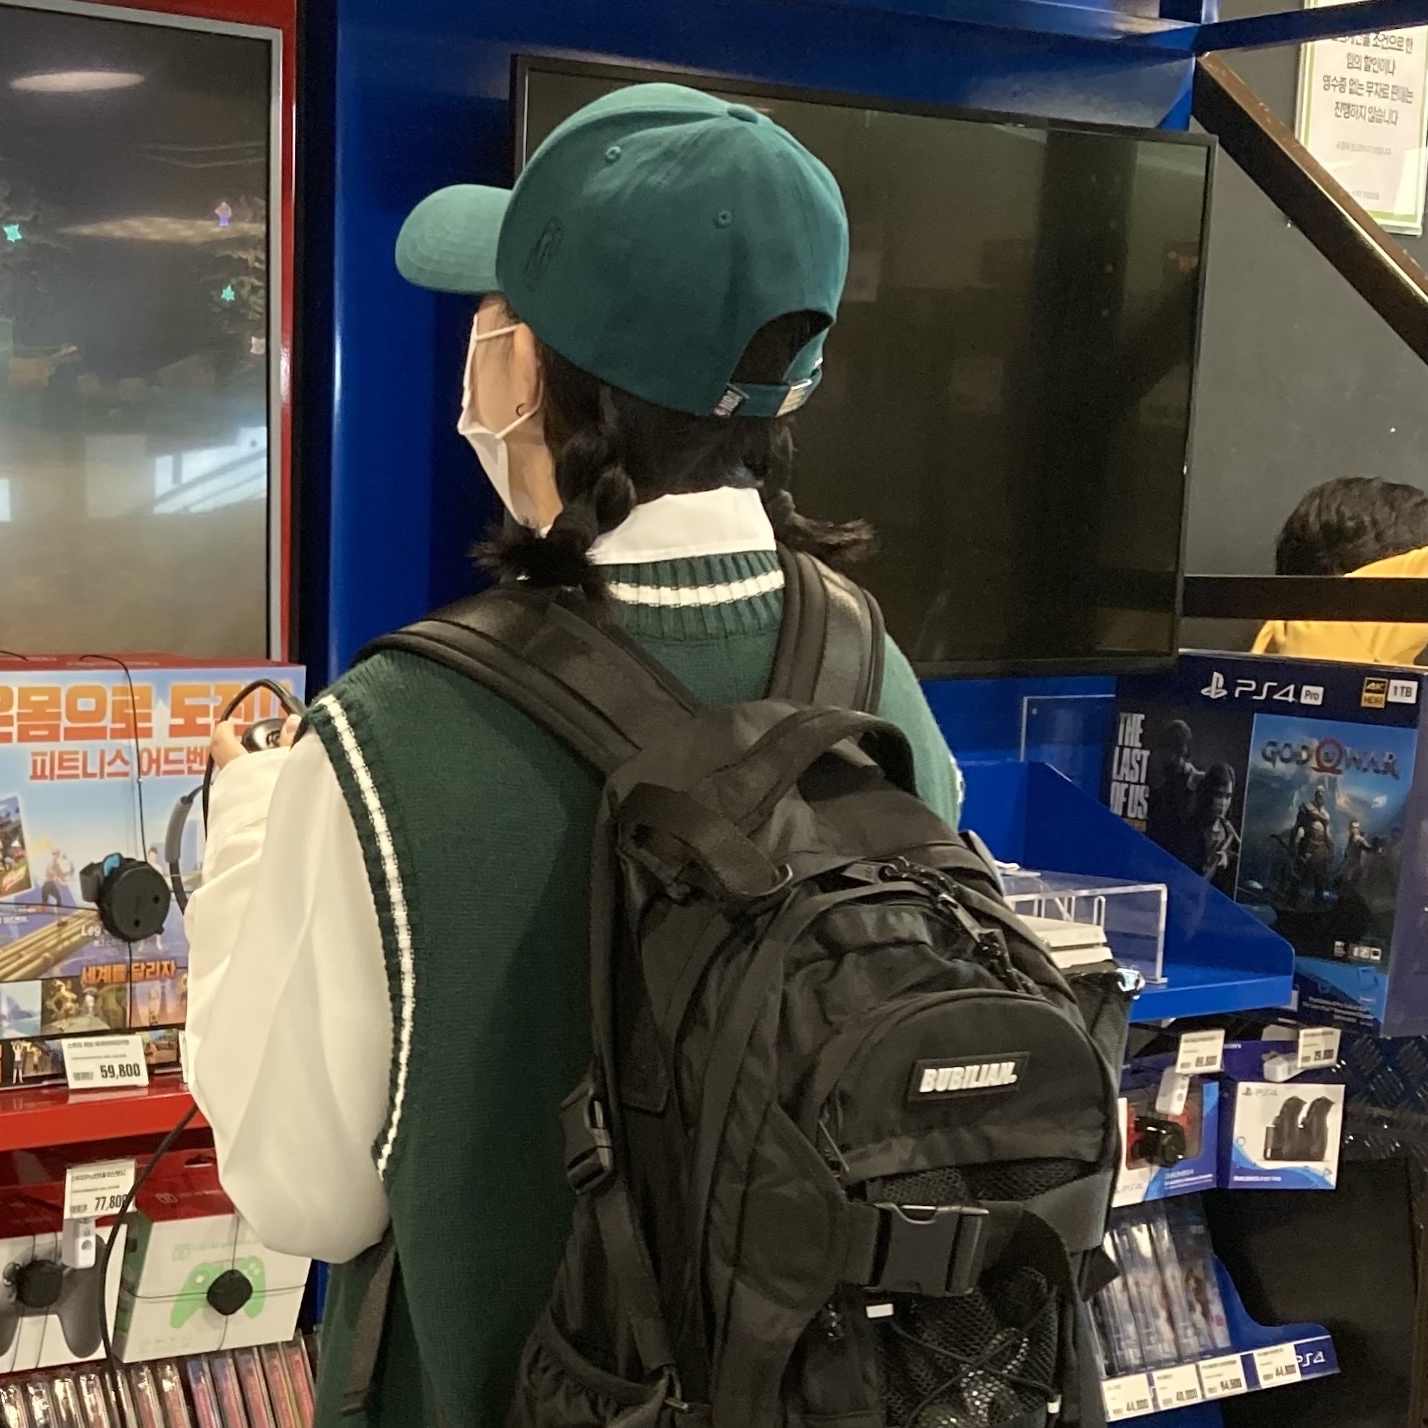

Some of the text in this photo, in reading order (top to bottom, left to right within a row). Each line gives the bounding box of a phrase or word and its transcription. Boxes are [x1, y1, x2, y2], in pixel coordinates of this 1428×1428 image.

[1234, 679, 1320, 703] PS4 Pro
[1118, 712, 1145, 748] THE
[30, 744, 210, 782] 피트니스 어드벤
[1112, 746, 1151, 783] LAST
[1261, 741, 1310, 768] GOD
[1344, 747, 1400, 780] WAR
[1110, 781, 1150, 820] OF US
[80, 963, 128, 985] 세계를
[99, 1063, 141, 1080] 59,800
